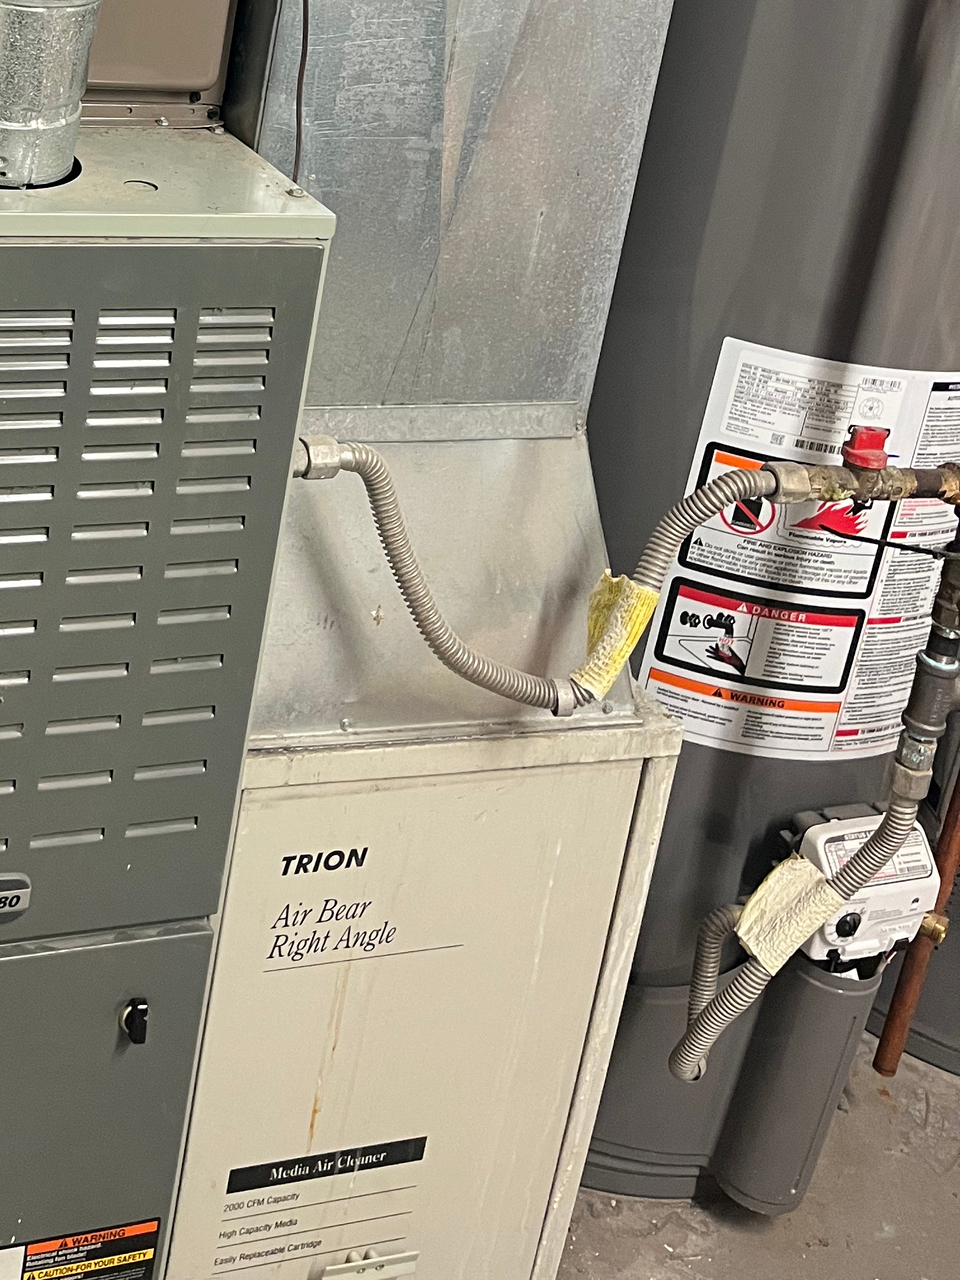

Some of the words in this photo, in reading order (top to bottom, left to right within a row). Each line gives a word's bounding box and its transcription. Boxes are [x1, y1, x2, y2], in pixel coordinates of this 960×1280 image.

[788, 532, 824, 542] Flammable
[736, 543, 748, 551] Can
[750, 546, 765, 554] result
[796, 554, 812, 564] injury
[743, 539, 757, 547] FIRE
[773, 544, 807, 556] EXPLOSION
[808, 550, 832, 559] HAZARD
[752, 605, 806, 622] DANGER
[730, 691, 785, 709] WARNING
[281, 847, 368, 876] TRION
[270, 902, 313, 929] Air
[315, 898, 372, 924] Bear
[266, 930, 330, 962] Right
[332, 921, 397, 951] Angle
[270, 1163, 309, 1181] Media
[313, 1159, 334, 1172] Air
[337, 1151, 387, 1169] Cleaner
[223, 1201, 245, 1213] 2000
[246, 1198, 265, 1209] CFM
[266, 1192, 300, 1205] Capacity
[72, 1229, 126, 1245] WARNING
[219, 1230, 237, 1239] High
[239, 1222, 273, 1236] Capacity
[274, 1219, 298, 1230] Media
[27, 1252, 57, 1261] Electrical
[58, 1247, 77, 1255] shock
[79, 1243, 102, 1251] hazard.
[214, 1255, 236, 1266] Easily
[239, 1246, 286, 1261] Replaceable
[287, 1240, 322, 1253] Cartridge
[26, 1258, 54, 1267] Rotating
[38, 1261, 92, 1279] CAUTION-FOR
[94, 1258, 115, 1268] YOUR
[117, 1251, 148, 1264] SAFETY
